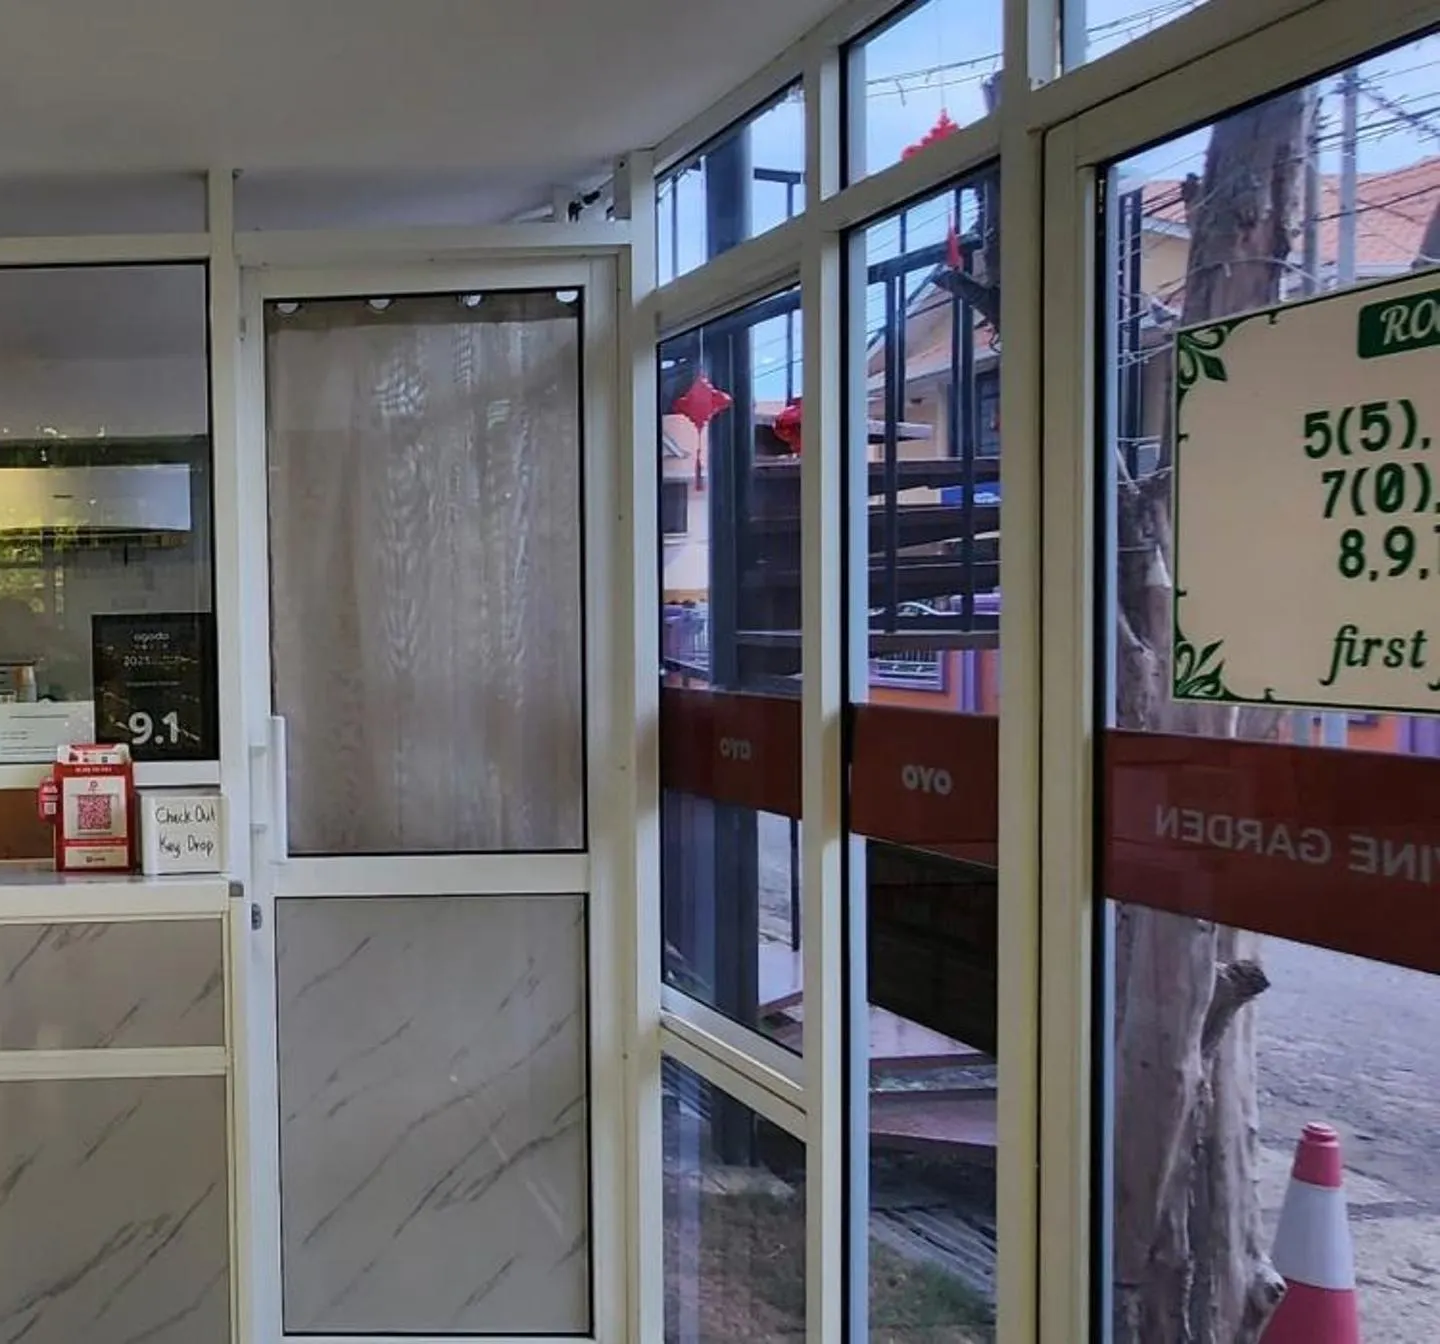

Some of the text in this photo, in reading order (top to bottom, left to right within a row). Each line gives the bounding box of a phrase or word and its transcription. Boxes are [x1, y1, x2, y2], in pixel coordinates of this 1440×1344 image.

[1318, 624, 1428, 686] first
[128, 711, 180, 745] 9.1
[187, 834, 214, 857] Drop
